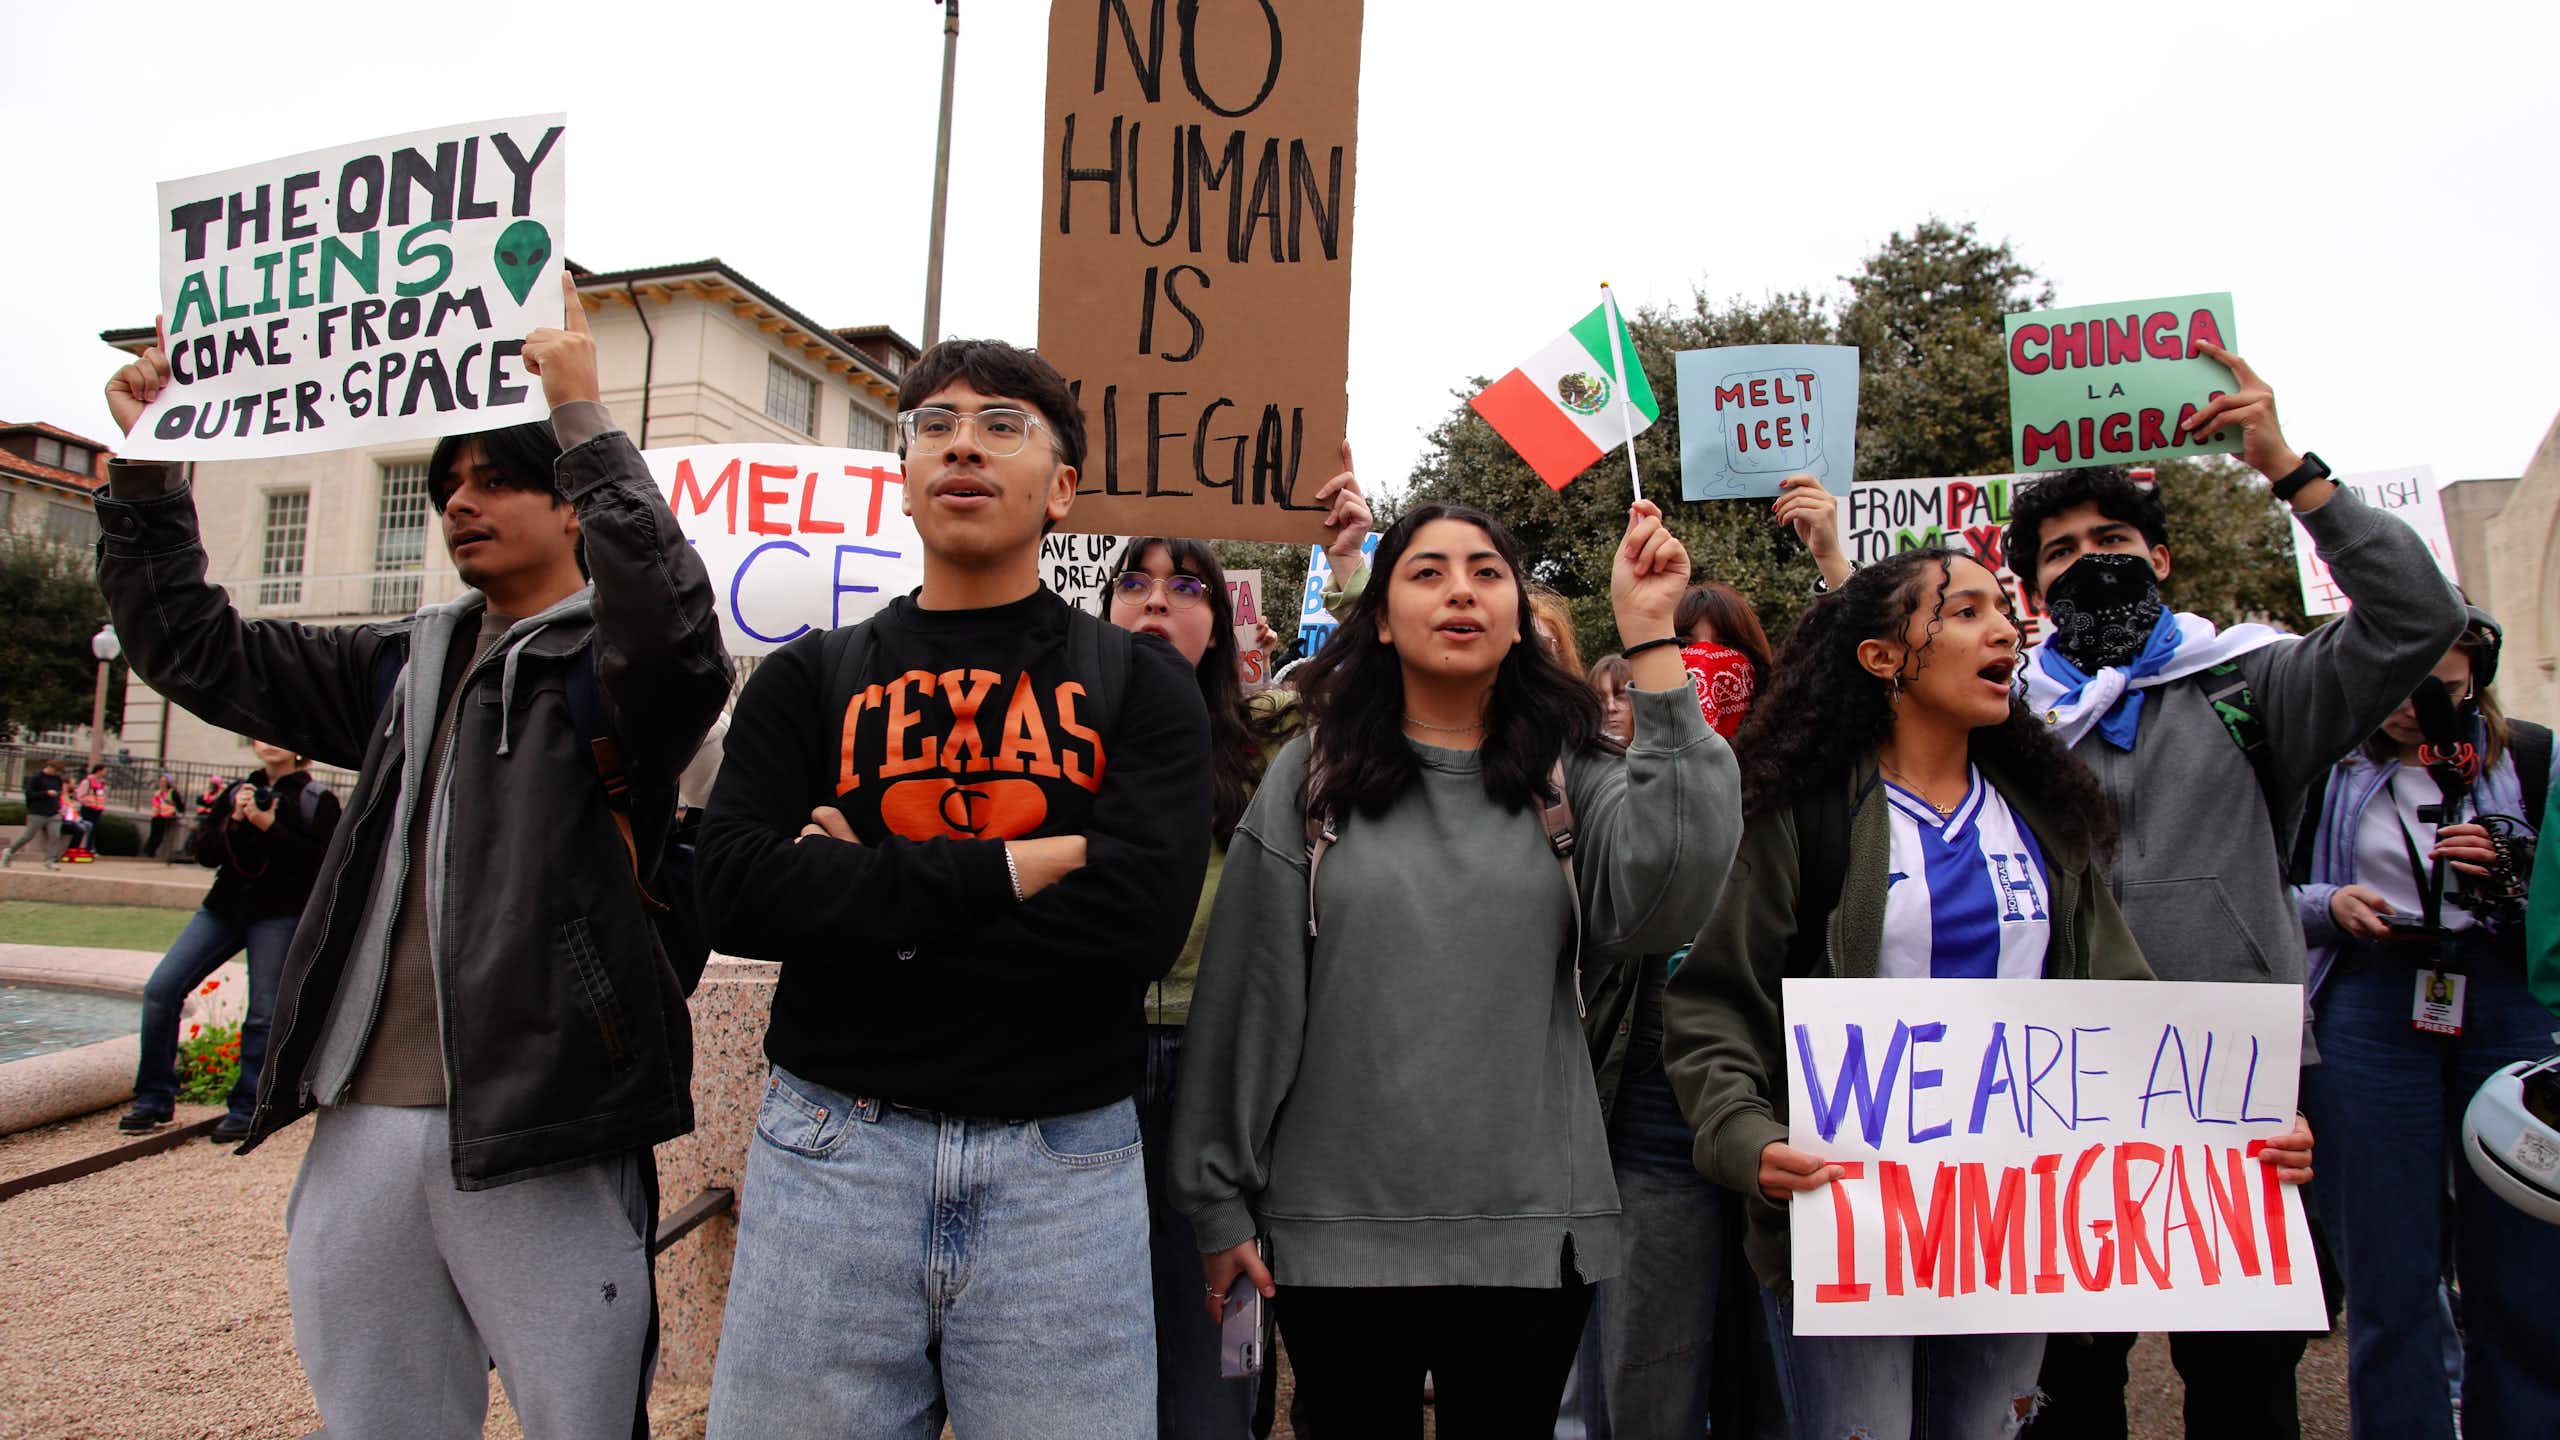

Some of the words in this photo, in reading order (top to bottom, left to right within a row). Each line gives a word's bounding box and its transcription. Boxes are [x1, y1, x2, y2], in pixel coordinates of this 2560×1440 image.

[1094, 0, 1282, 118] NO
[171, 171, 320, 261] THE
[336, 126, 565, 233] ONLY
[1060, 113, 1343, 264] HUMAN
[170, 221, 454, 335] ALIENS
[1139, 264, 1210, 362] IS
[171, 318, 291, 385] COME
[319, 286, 492, 363] FROM
[2010, 309, 2227, 375] CHINGA
[154, 380, 324, 440] OUTER
[343, 339, 529, 418] SPACE
[1715, 374, 1815, 411] MELT
[1737, 413, 1811, 452] ICE!
[2088, 382, 2125, 399] LA
[669, 458, 903, 536] MELT
[1849, 527, 1889, 562] TO
[1850, 486, 1942, 529] FROM
[1947, 479, 2036, 530] PAL
[688, 539, 902, 643] CE
[1054, 565, 1115, 594] DREA
[1087, 534, 1117, 562] UP
[837, 668, 1106, 798] TEXAS
[2415, 1020, 2456, 1035] PRESS
[1794, 1019, 1952, 1150] WE
[1968, 1022, 2110, 1137] ARE
[2138, 1024, 2282, 1129] ALL
[1815, 1139, 2293, 1303] IMMIGRANT
